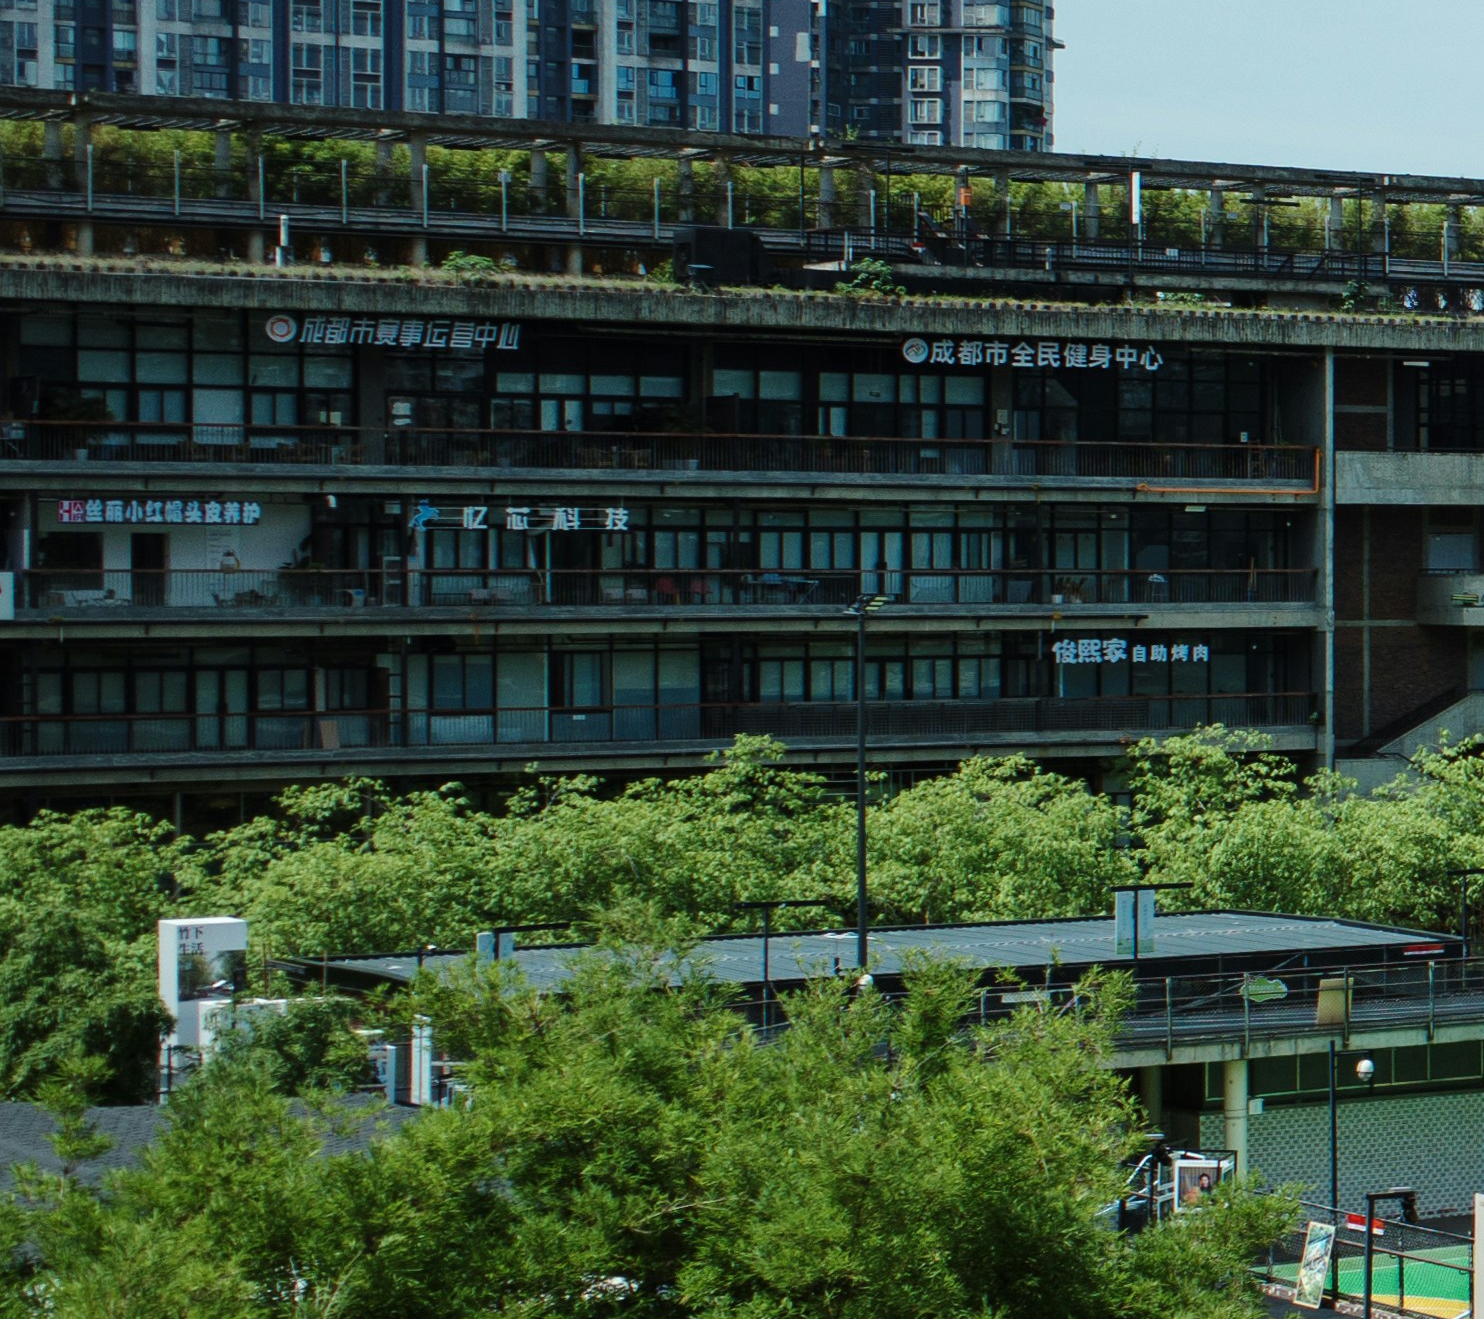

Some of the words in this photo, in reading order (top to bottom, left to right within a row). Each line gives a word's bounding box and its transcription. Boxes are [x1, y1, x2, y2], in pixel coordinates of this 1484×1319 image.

[299, 318, 521, 350] 成都市赛事运营中心
[929, 340, 1163, 371] 成都市全民健身中心
[85, 499, 262, 524] 丝丽小红帽头皮养护
[463, 506, 629, 530] 忆芯科技
[1132, 643, 1209, 663] 自助烤肉
[179, 926, 203, 939] 竹下
[179, 942, 203, 955] 生活
